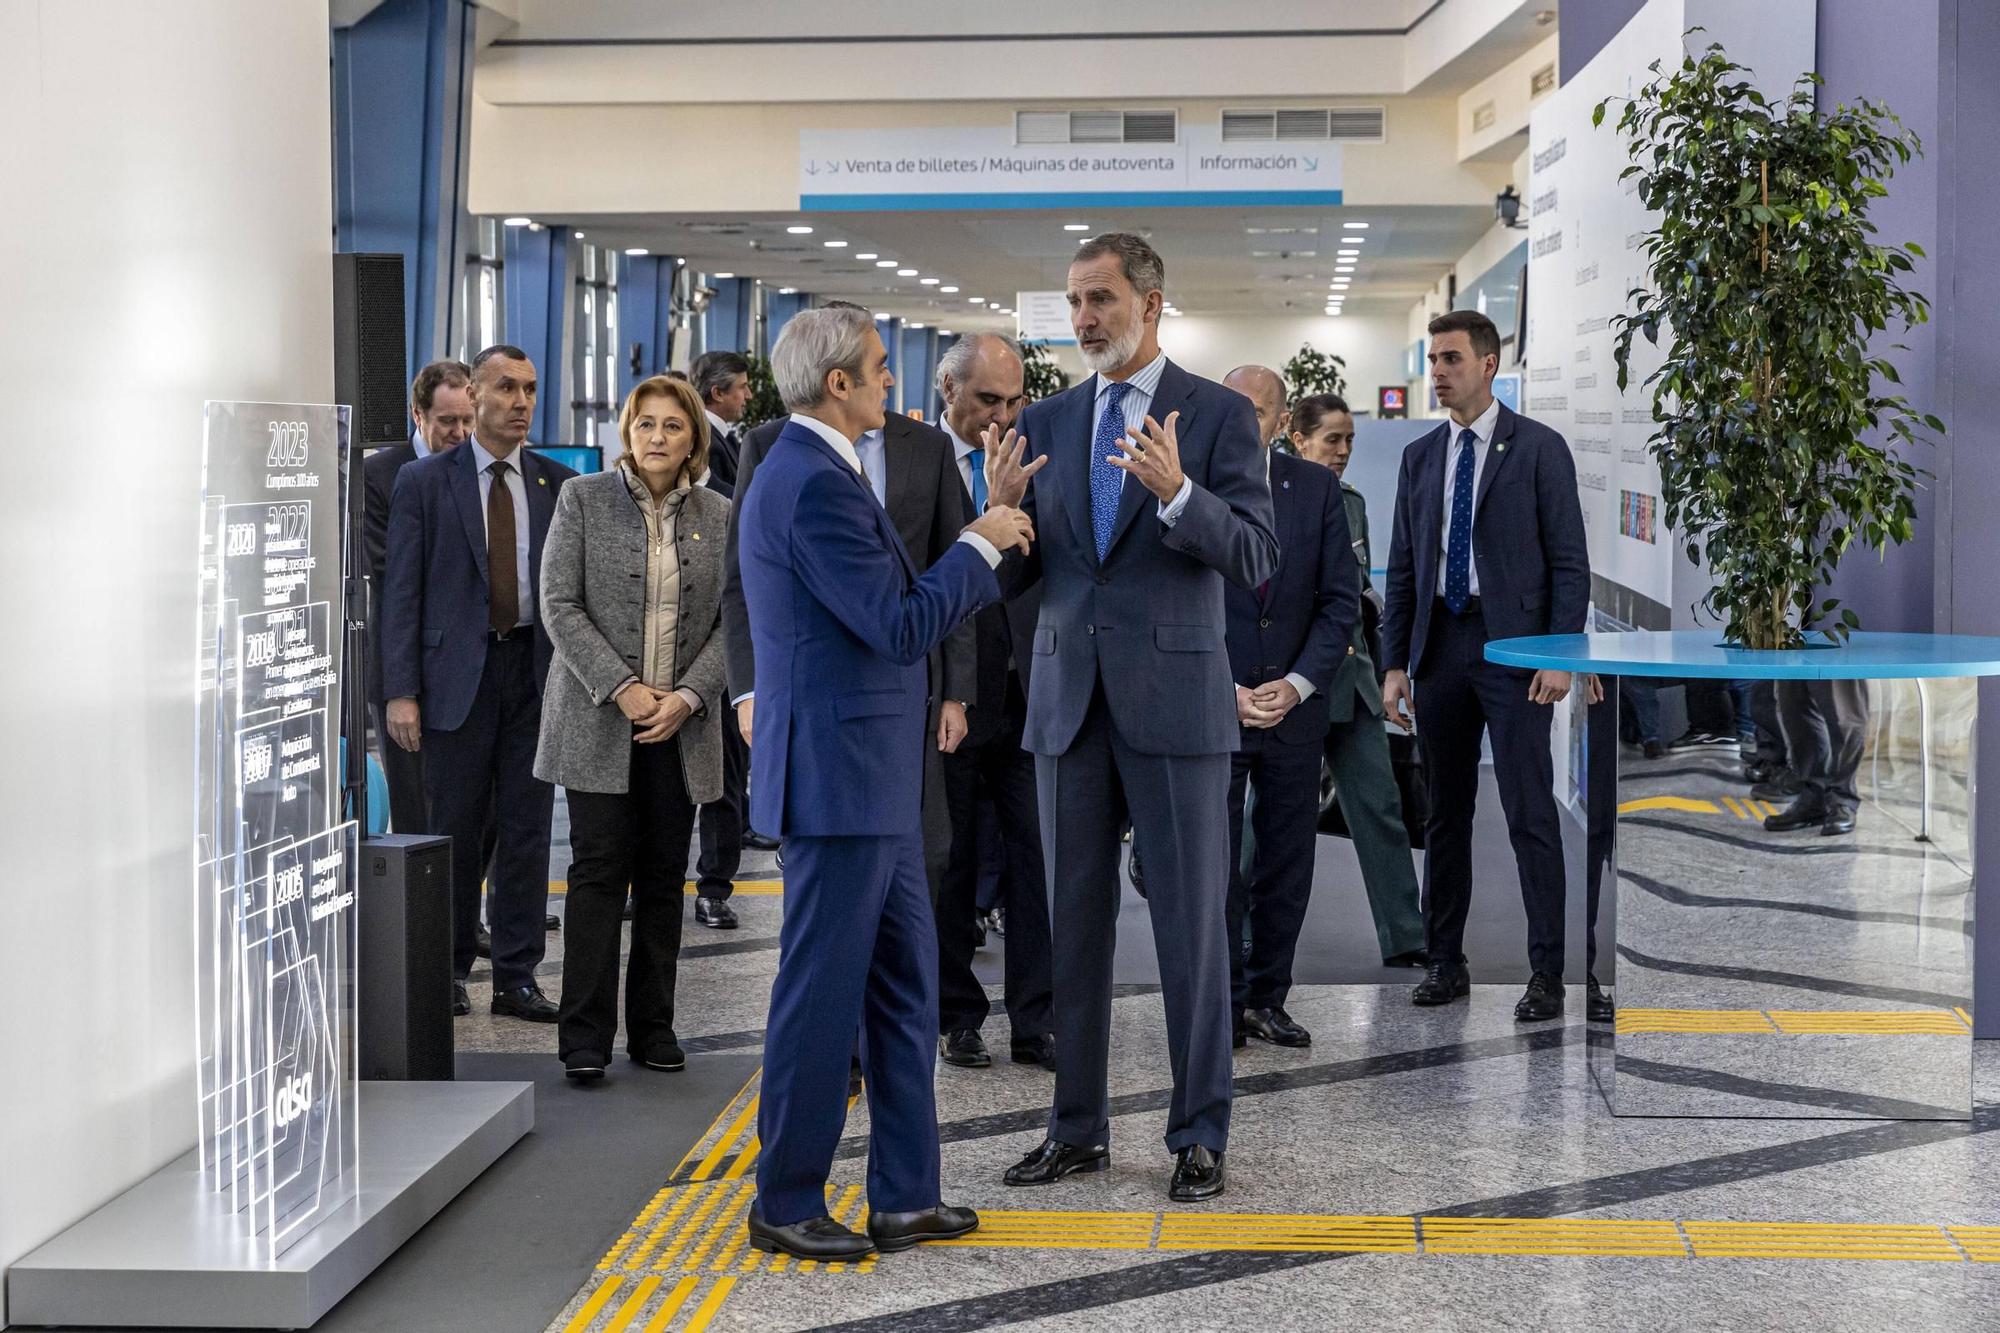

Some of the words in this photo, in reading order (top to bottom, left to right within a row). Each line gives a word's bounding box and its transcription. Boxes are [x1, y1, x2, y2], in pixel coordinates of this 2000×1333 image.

[845, 159, 892, 173] Venta
[896, 158, 915, 173] de
[919, 158, 978, 173] billetes
[989, 157, 1065, 173] Máquinas
[1069, 157, 1089, 171] de
[1092, 157, 1175, 171] autoventa
[1200, 154, 1297, 170] Información
[266, 421, 309, 468] 2023
[266, 473, 296, 490] Cumplimos
[227, 522, 256, 557] 2020
[265, 664, 282, 679] Primer
[281, 734, 312, 758] Adquisición
[277, 864, 304, 906] 2005
[276, 1072, 312, 1128] alsa
